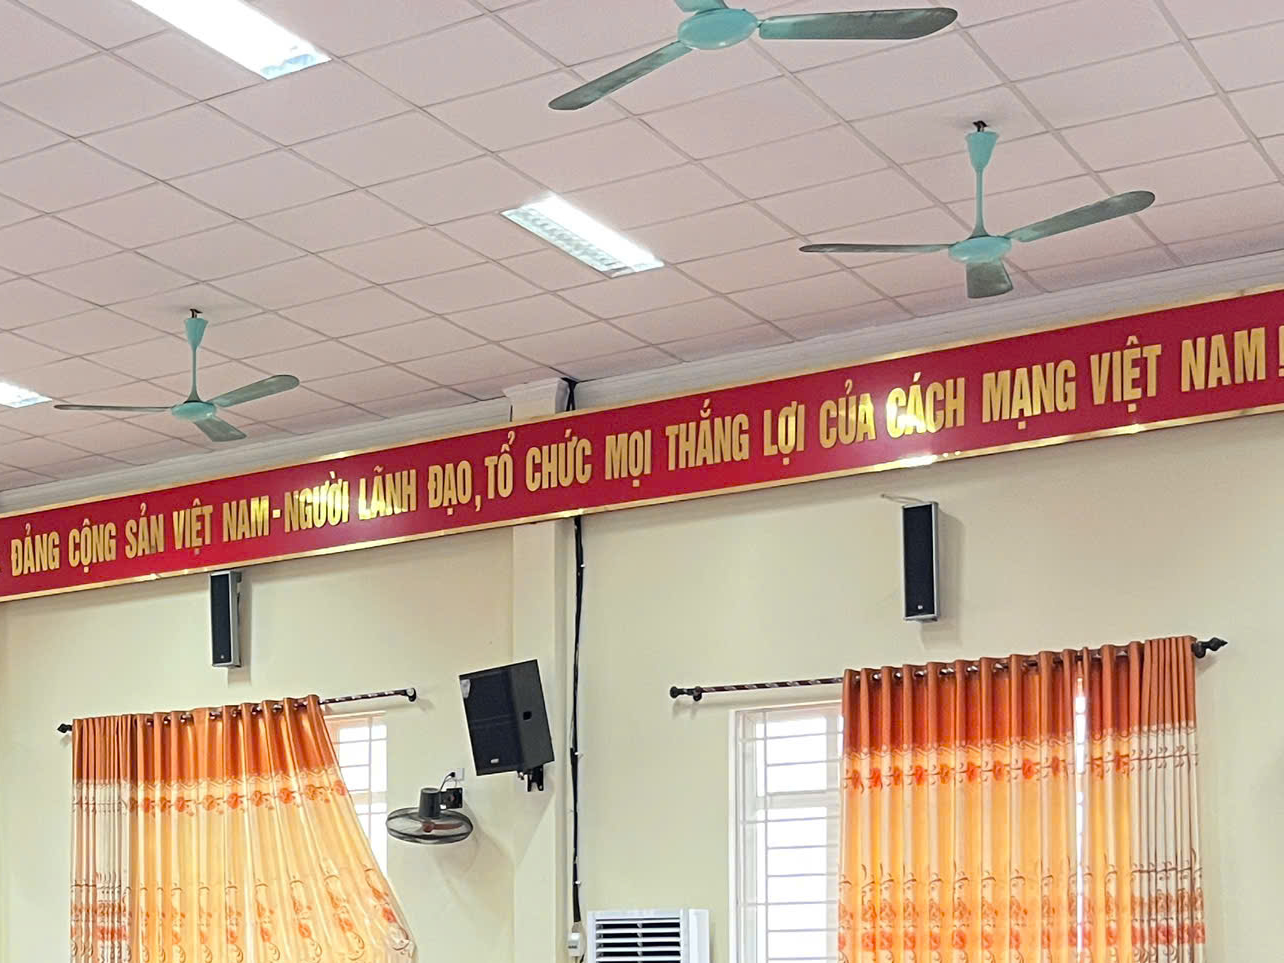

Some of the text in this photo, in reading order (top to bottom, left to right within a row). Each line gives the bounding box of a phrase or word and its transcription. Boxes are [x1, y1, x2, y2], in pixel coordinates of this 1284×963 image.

[11, 522, 60, 577] ĐẢNG
[68, 518, 117, 573] CỘNG
[125, 502, 165, 559] SẢN
[173, 497, 213, 555] VIỆT
[358, 465, 417, 520] LÃNH
[484, 430, 514, 499] TỔ
[525, 428, 592, 492] CHỨC
[605, 429, 652, 487] MỌI
[665, 398, 750, 471] THẮNG
[763, 400, 805, 465] LỢI
[819, 378, 877, 449] CỦA
[886, 371, 965, 438] CÁCH
[982, 359, 1077, 430] MẠNG
[1090, 335, 1162, 413] VIỆT
